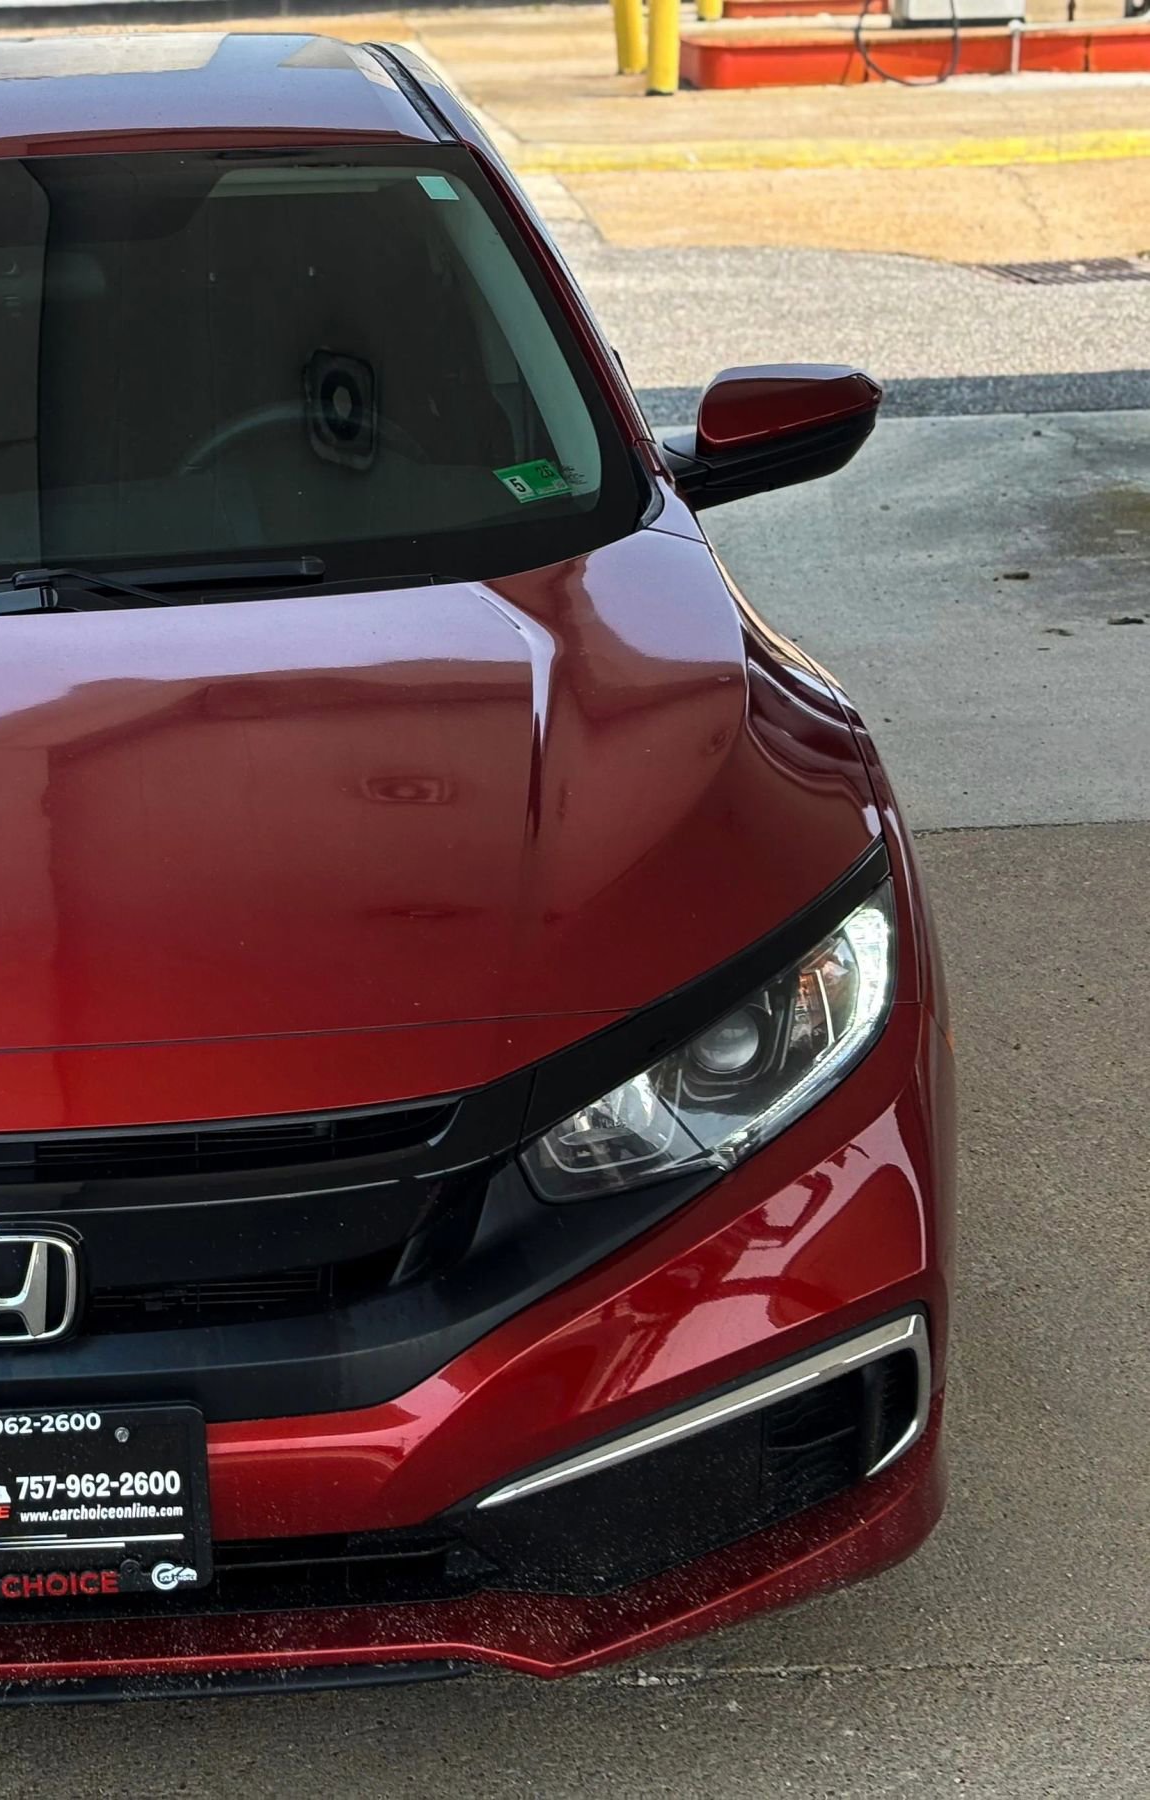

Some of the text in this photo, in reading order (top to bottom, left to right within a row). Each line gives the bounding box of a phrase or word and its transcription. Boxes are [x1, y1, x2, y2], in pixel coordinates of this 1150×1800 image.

[509, 478, 526, 493] 5
[16, 1471, 181, 1500] 757-962-2600
[20, 1503, 183, 1523] www.carchoiceonline.com
[1, 1570, 120, 1598] CHOICE
